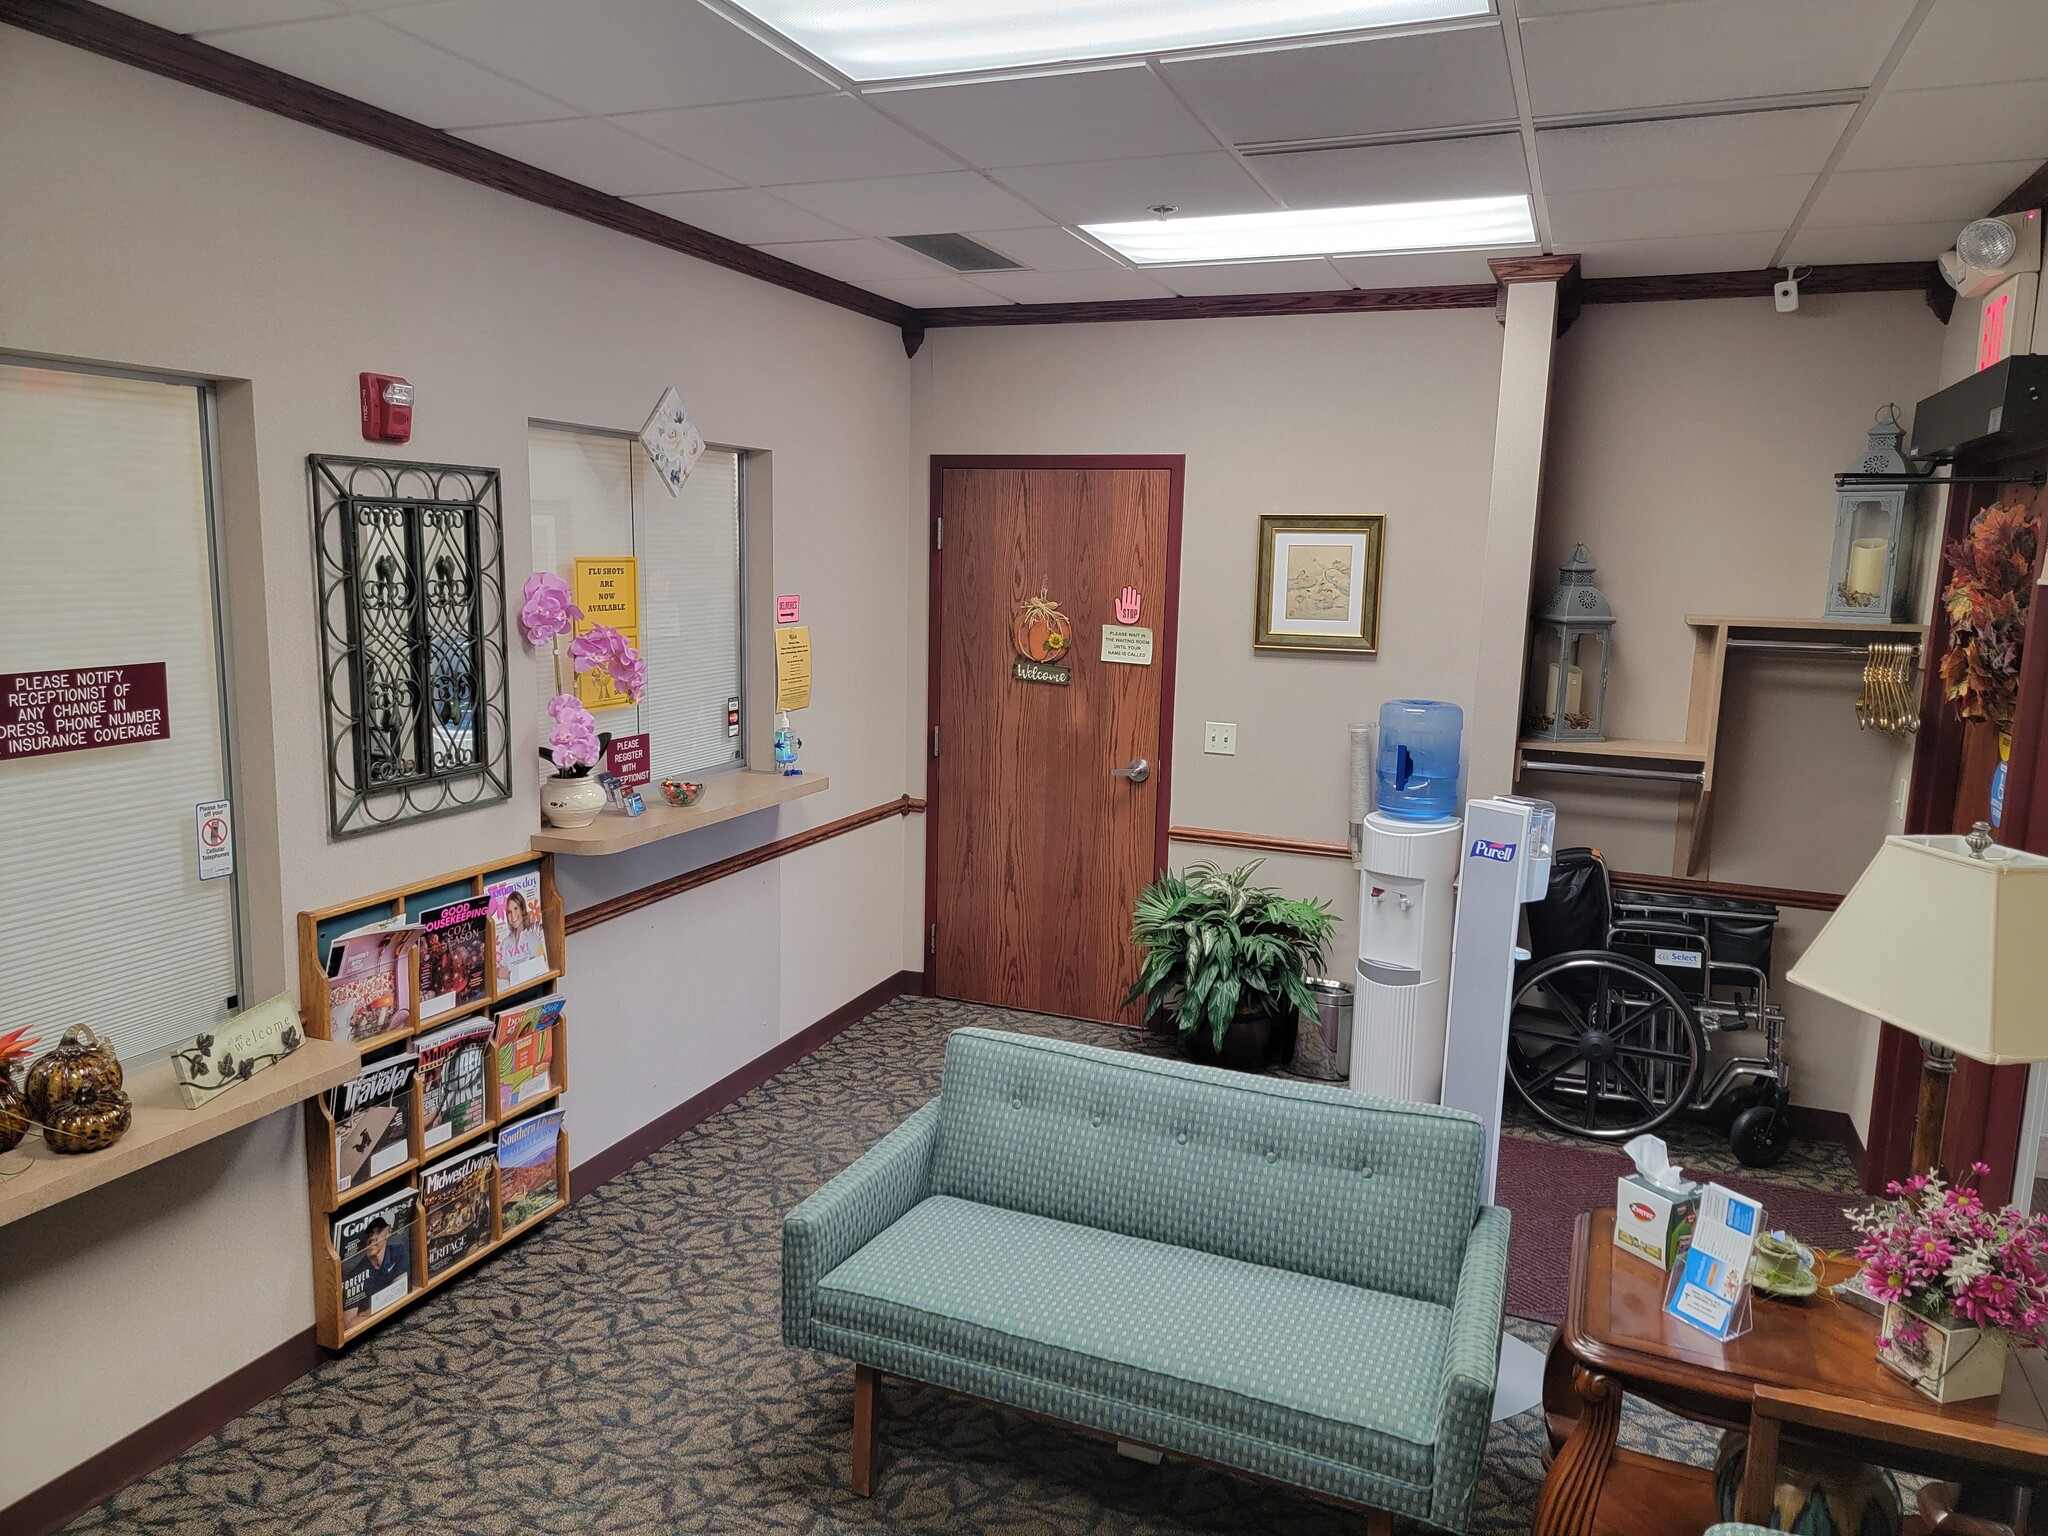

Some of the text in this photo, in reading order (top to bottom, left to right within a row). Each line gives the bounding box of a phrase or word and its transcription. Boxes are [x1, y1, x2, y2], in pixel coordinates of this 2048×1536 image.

[588, 567, 624, 576] FLU SHOTS
[600, 580, 614, 588] ARE
[598, 593, 616, 601] NOW
[588, 603, 626, 613] AVAILABLE
[1122, 608, 1138, 619] STOP
[16, 670, 124, 691] PLEASE NOTIFY
[1017, 663, 1067, 683] Welcome
[9, 683, 131, 707] RECEPTIONIST OF
[18, 699, 126, 722] ANY CHANGE IN
[56, 716, 102, 732] PHONE
[109, 709, 161, 726] NUMBER
[9, 723, 160, 754] INSURANCE COVERAGE
[617, 739, 640, 751] PLEASE
[610, 750, 643, 763] REGISTER
[622, 763, 637, 773] WITH
[620, 771, 649, 785] EPTIONIST
[212, 810, 223, 818] your
[202, 851, 230, 862] Telephones
[206, 846, 225, 854] Cellular
[1475, 840, 1512, 861] Purell
[522, 877, 537, 893] day
[426, 906, 489, 932] OUSEKEEPING
[441, 903, 470, 919] GOOD
[447, 921, 474, 937] COZY
[508, 943, 529, 957] YAY!
[1671, 953, 1697, 962] Select
[234, 1016, 291, 1052] welcome
[343, 1065, 415, 1112] Traveler
[502, 1124, 536, 1148] Southern
[347, 1281, 365, 1299] RORY
